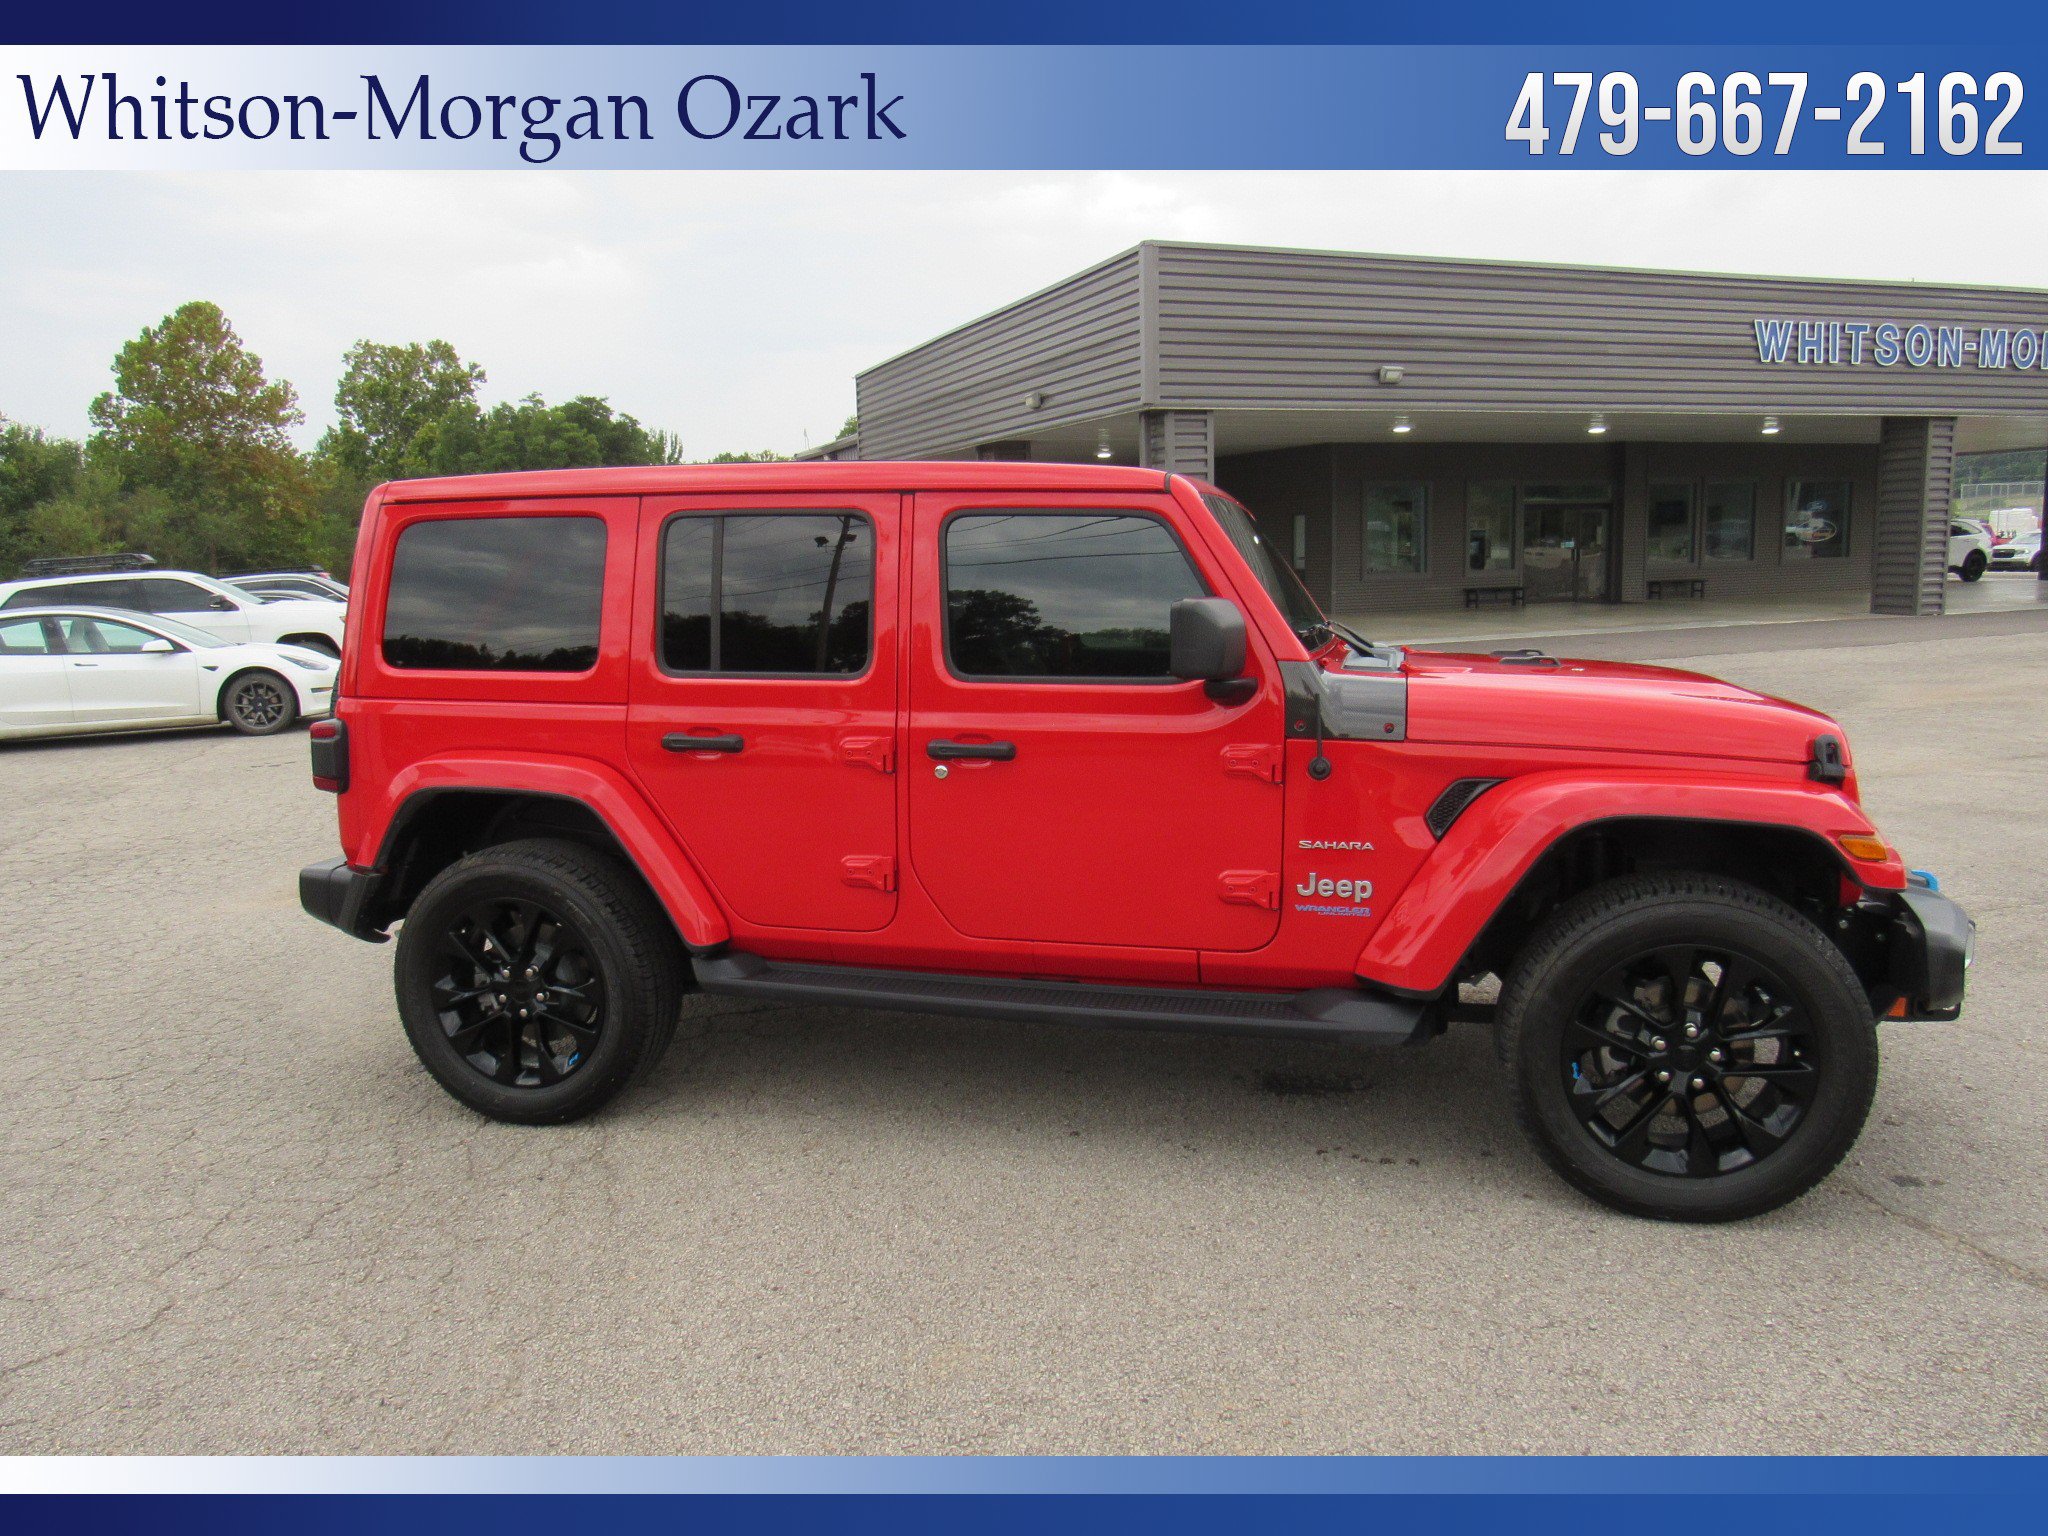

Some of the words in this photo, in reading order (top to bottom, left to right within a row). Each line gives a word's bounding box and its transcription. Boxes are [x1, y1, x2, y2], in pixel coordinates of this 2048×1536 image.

[1298, 840, 1375, 851] SAHARA
[1296, 872, 1373, 904] Jeep
[1294, 904, 1371, 915] WRANGLER
